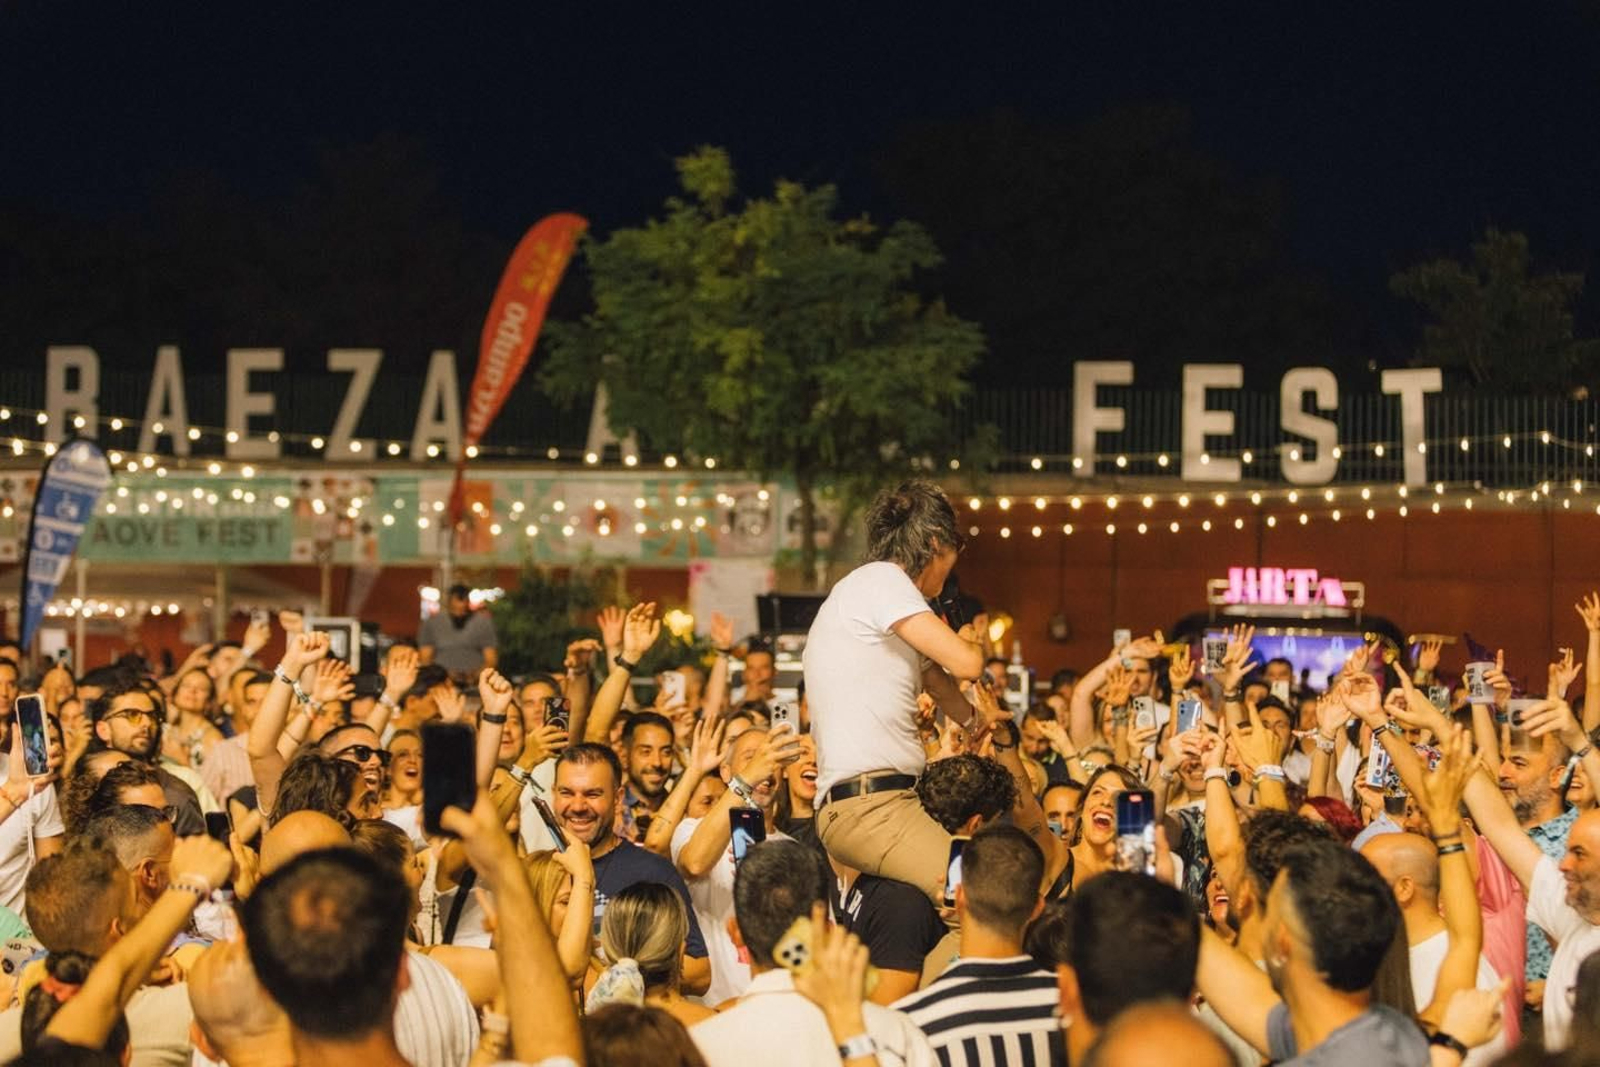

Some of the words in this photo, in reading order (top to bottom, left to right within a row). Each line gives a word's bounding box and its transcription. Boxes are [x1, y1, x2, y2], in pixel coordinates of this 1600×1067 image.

[45, 344, 463, 462] BAEZA
[1071, 360, 1443, 487] FEST
[92, 517, 180, 546] AOVE
[196, 517, 281, 546] FEST
